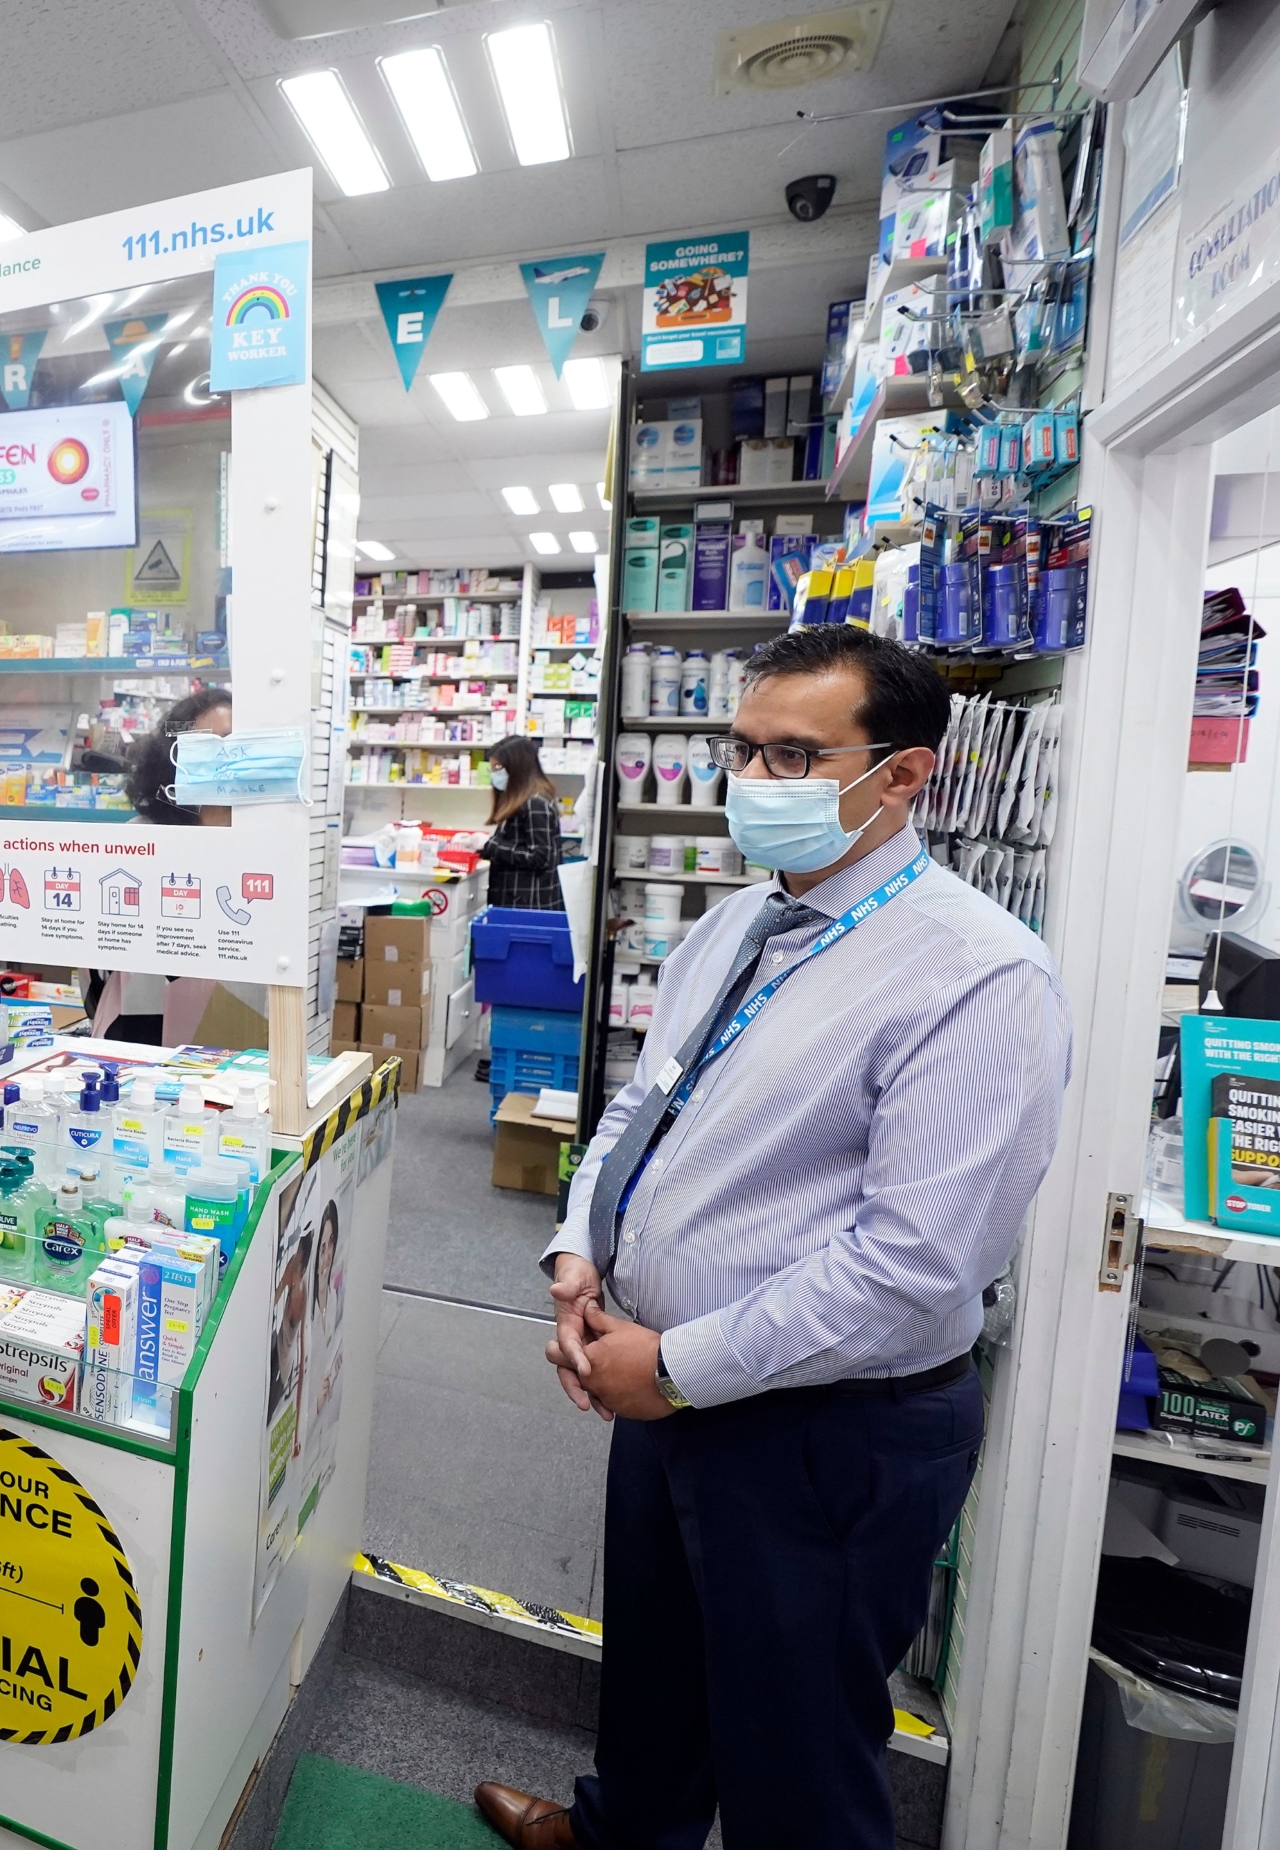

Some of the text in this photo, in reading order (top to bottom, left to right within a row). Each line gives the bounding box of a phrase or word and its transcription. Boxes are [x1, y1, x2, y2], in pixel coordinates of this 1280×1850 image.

[122, 207, 275, 261] 111.nhs.uk
[675, 243, 718, 257] GOING
[649, 251, 744, 272] SOMEWHERE?
[222, 271, 298, 303] THANK YOU
[547, 297, 573, 329] L
[396, 311, 424, 344] E
[232, 327, 283, 348] KEY
[227, 346, 287, 362] WORKER
[122, 355, 147, 379] A
[4, 364, 27, 392] R
[216, 747, 251, 759] ASK
[3, 837, 55, 852] actions
[58, 840, 100, 854] when
[104, 842, 156, 856] unwell
[55, 882, 70, 890] DAY
[246, 878, 270, 893] 111
[883, 873, 910, 897] NHS
[52, 892, 73, 908] 14
[173, 889, 188, 897] DAY
[850, 897, 879, 922] NHS
[41, 917, 53, 925] Stay
[48, 925, 61, 933] days
[820, 922, 846, 947] NHS
[55, 933, 85, 941] symptoms.
[156, 933, 195, 942] improvement
[218, 938, 253, 946] coronavirus
[156, 948, 201, 957] medical advice.
[176, 942, 192, 950] days,
[218, 953, 248, 961] 111.nhs.uk
[743, 993, 768, 1019] NHS
[720, 1020, 741, 1045] NHS
[1204, 1037, 1252, 1050] QUITTING
[1204, 1048, 1252, 1061] WITH THE
[70, 1130, 100, 1139] CUTICURA
[190, 1205, 230, 1217] HAND WASH
[44, 1241, 80, 1256] Carex
[139, 1292, 157, 1381] answer
[95, 1350, 108, 1420] SENSODYNE
[1162, 1391, 1195, 1416] 100
[1195, 1409, 1229, 1421] LATEX
